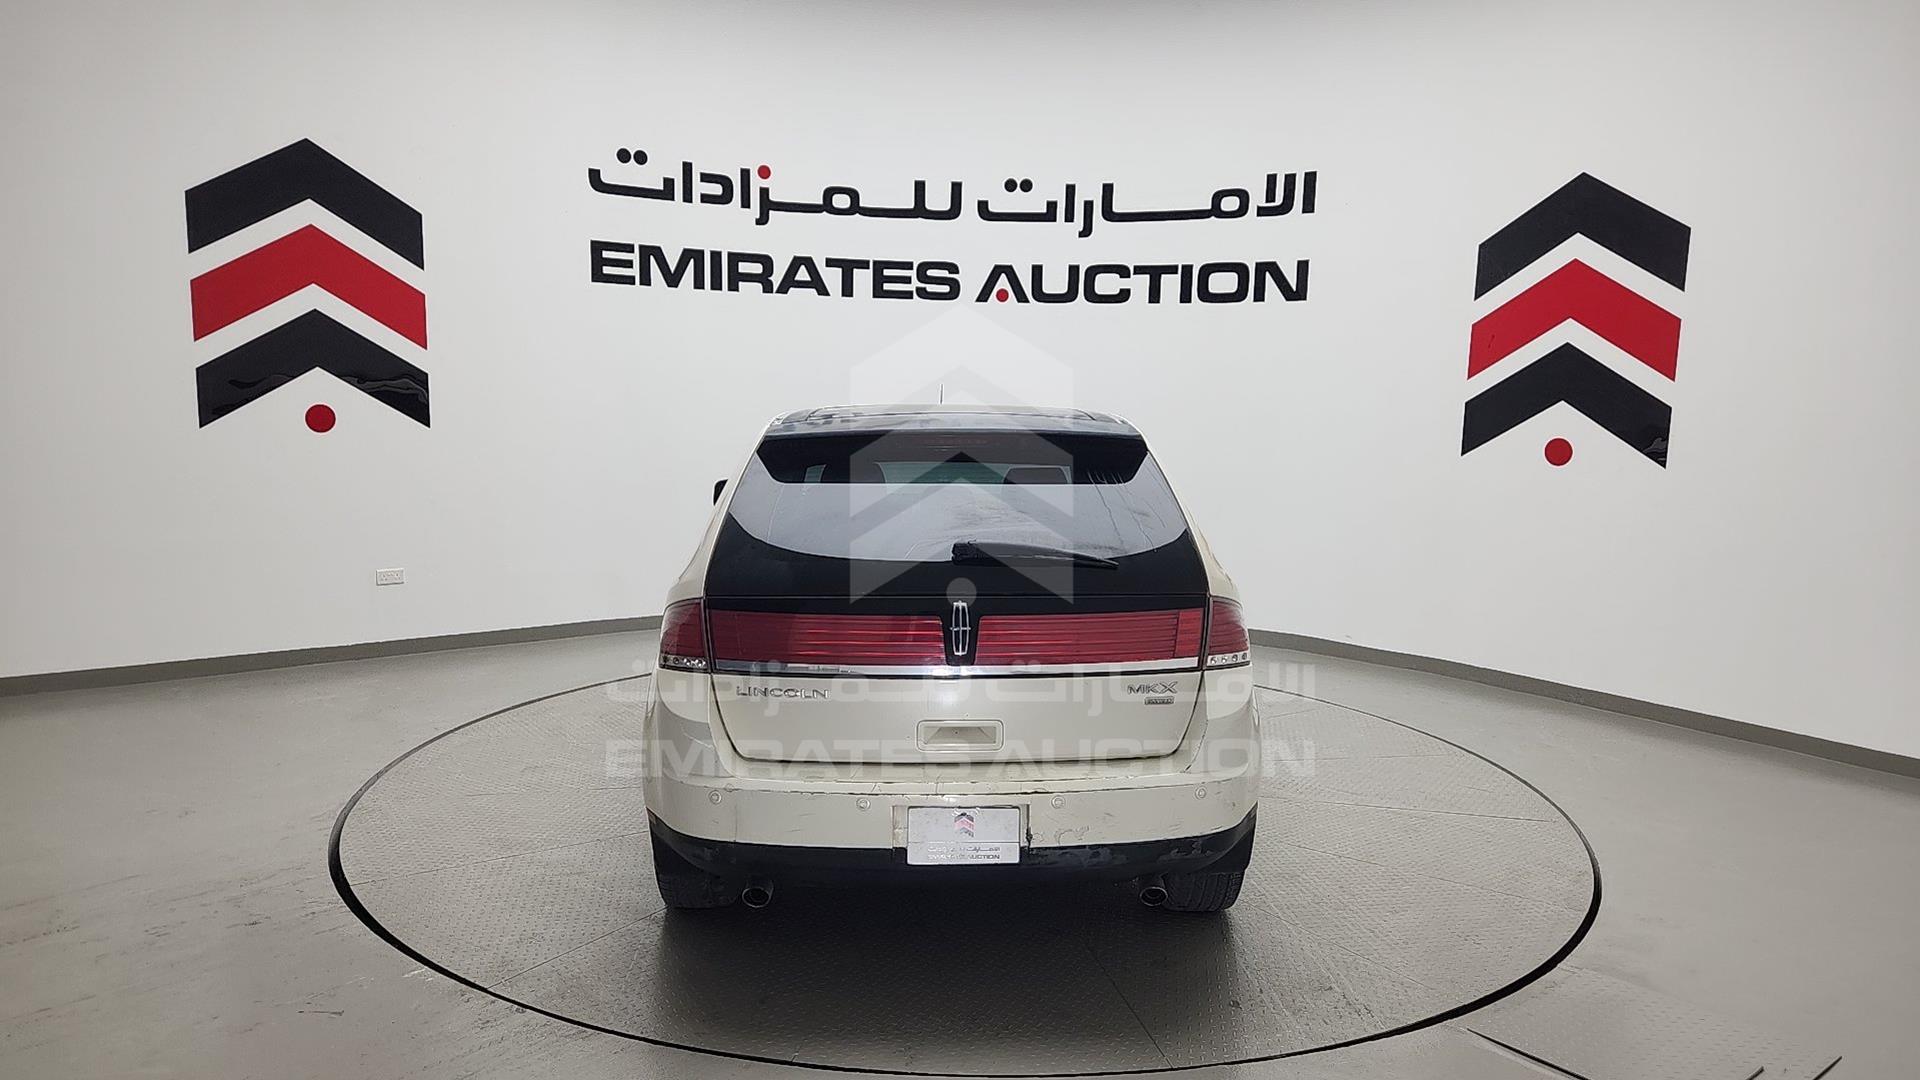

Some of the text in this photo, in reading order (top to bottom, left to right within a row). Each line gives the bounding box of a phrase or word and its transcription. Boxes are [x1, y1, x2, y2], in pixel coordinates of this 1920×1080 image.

[588, 147, 1317, 238] الامارات للمزادات
[590, 239, 1310, 304] EMIRATES AUCTION
[736, 685, 830, 699] LINCOLN
[1127, 681, 1178, 694] MKX
